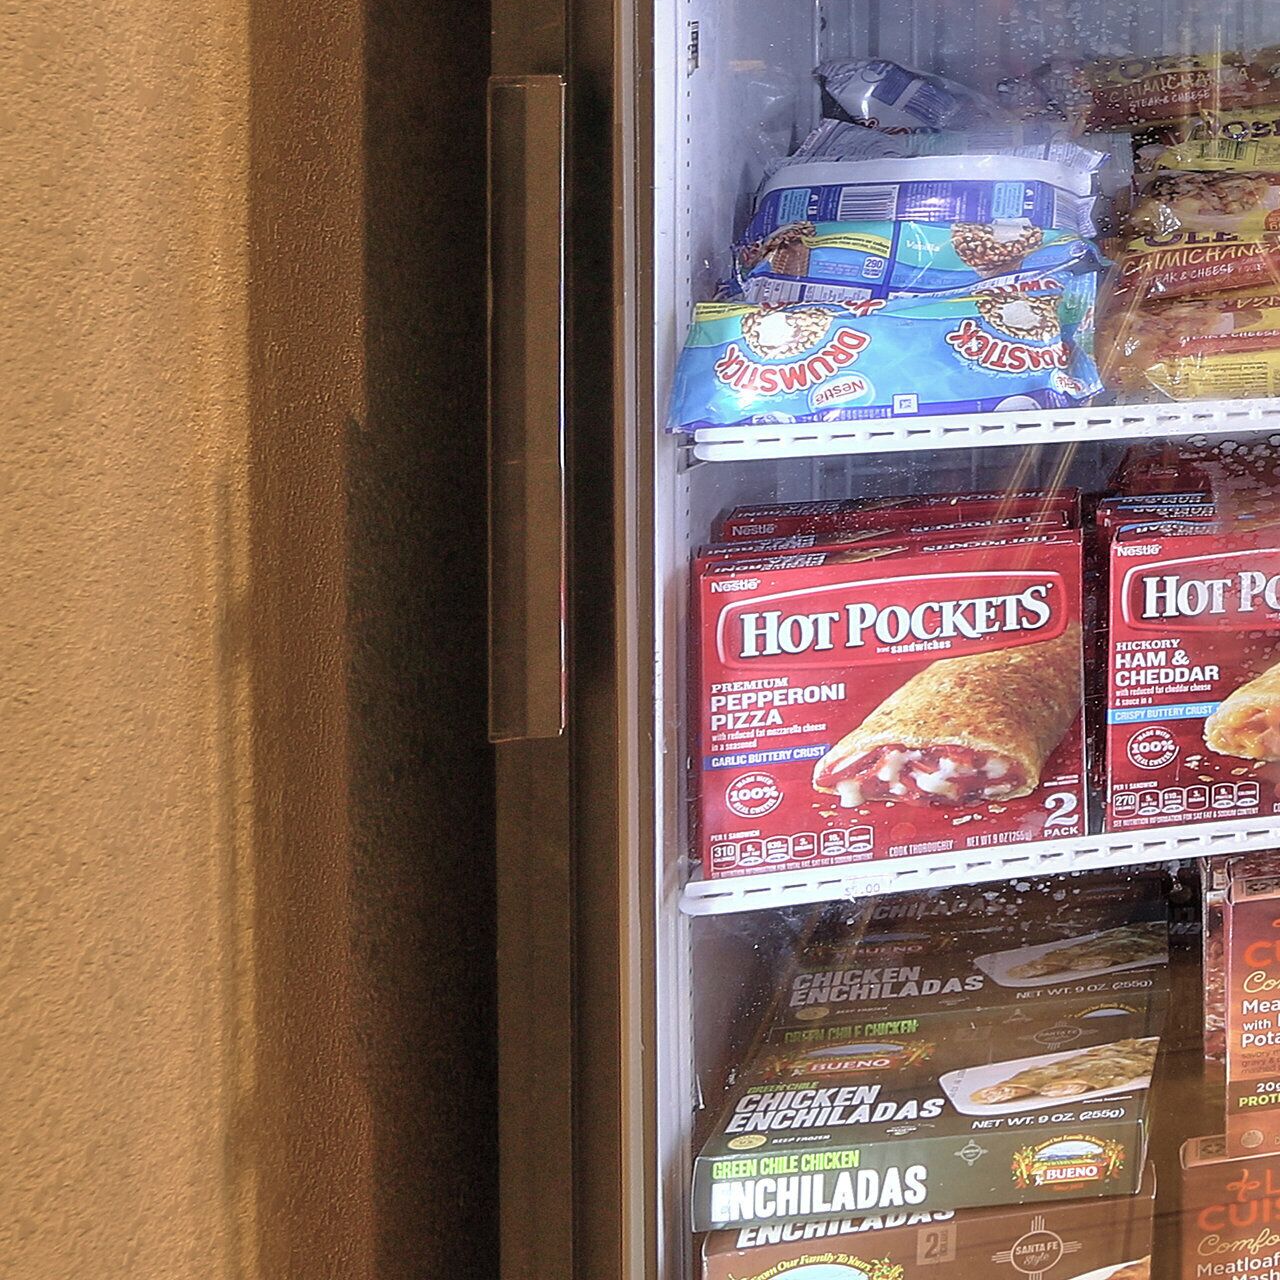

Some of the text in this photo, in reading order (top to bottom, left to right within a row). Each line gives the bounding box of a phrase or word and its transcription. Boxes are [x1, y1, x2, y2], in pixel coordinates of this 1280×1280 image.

[1189, 262, 1235, 279] CHEESE
[714, 327, 872, 394] DRUMSTICK
[1117, 545, 1162, 557] Nestlé
[711, 578, 761, 593] Nestlé
[1142, 574, 1233, 619] HOT
[740, 583, 1054, 658] HOT POCKETS
[890, 640, 951, 655] sandwiches
[1116, 639, 1180, 652] HICKORY
[1116, 649, 1190, 669] HAM &
[711, 677, 789, 694] PREMIUM
[1115, 665, 1220, 688] CHEDDAR
[1165, 683, 1211, 694] cheddar cheese
[711, 683, 846, 713] PEPPERONI
[711, 709, 783, 731] PIZZA
[1115, 705, 1212, 721] CRISPY BUTTERY CRUST
[727, 723, 827, 740] reduced mozzarella cheese
[1131, 739, 1175, 754] 100%
[711, 747, 827, 768] GARLIC BUTTERY CRUST
[730, 786, 779, 802] 100%
[1115, 795, 1135, 807] 270
[1044, 792, 1079, 828] 2
[1043, 826, 1079, 838] PACK
[714, 847, 735, 857] 310
[793, 966, 921, 992] CHICKEN
[789, 975, 985, 1007] ENCHILADAS
[863, 1019, 920, 1038] CHICKEN
[1243, 1017, 1271, 1031] with
[808, 1057, 892, 1073] BUENO
[736, 1084, 882, 1113] CHICKEN
[724, 1098, 946, 1134] ENCHILADAS
[972, 1107, 1127, 1130] NET WT. OZ. (255g)
[712, 1149, 860, 1179] GREEN CHILE CHICKEN
[1045, 1166, 1099, 1181] BUENO
[710, 1165, 929, 1224] ENCHILADAS
[1016, 1242, 1059, 1255] SANTA FE
[1197, 1251, 1280, 1277] Meatloaf
